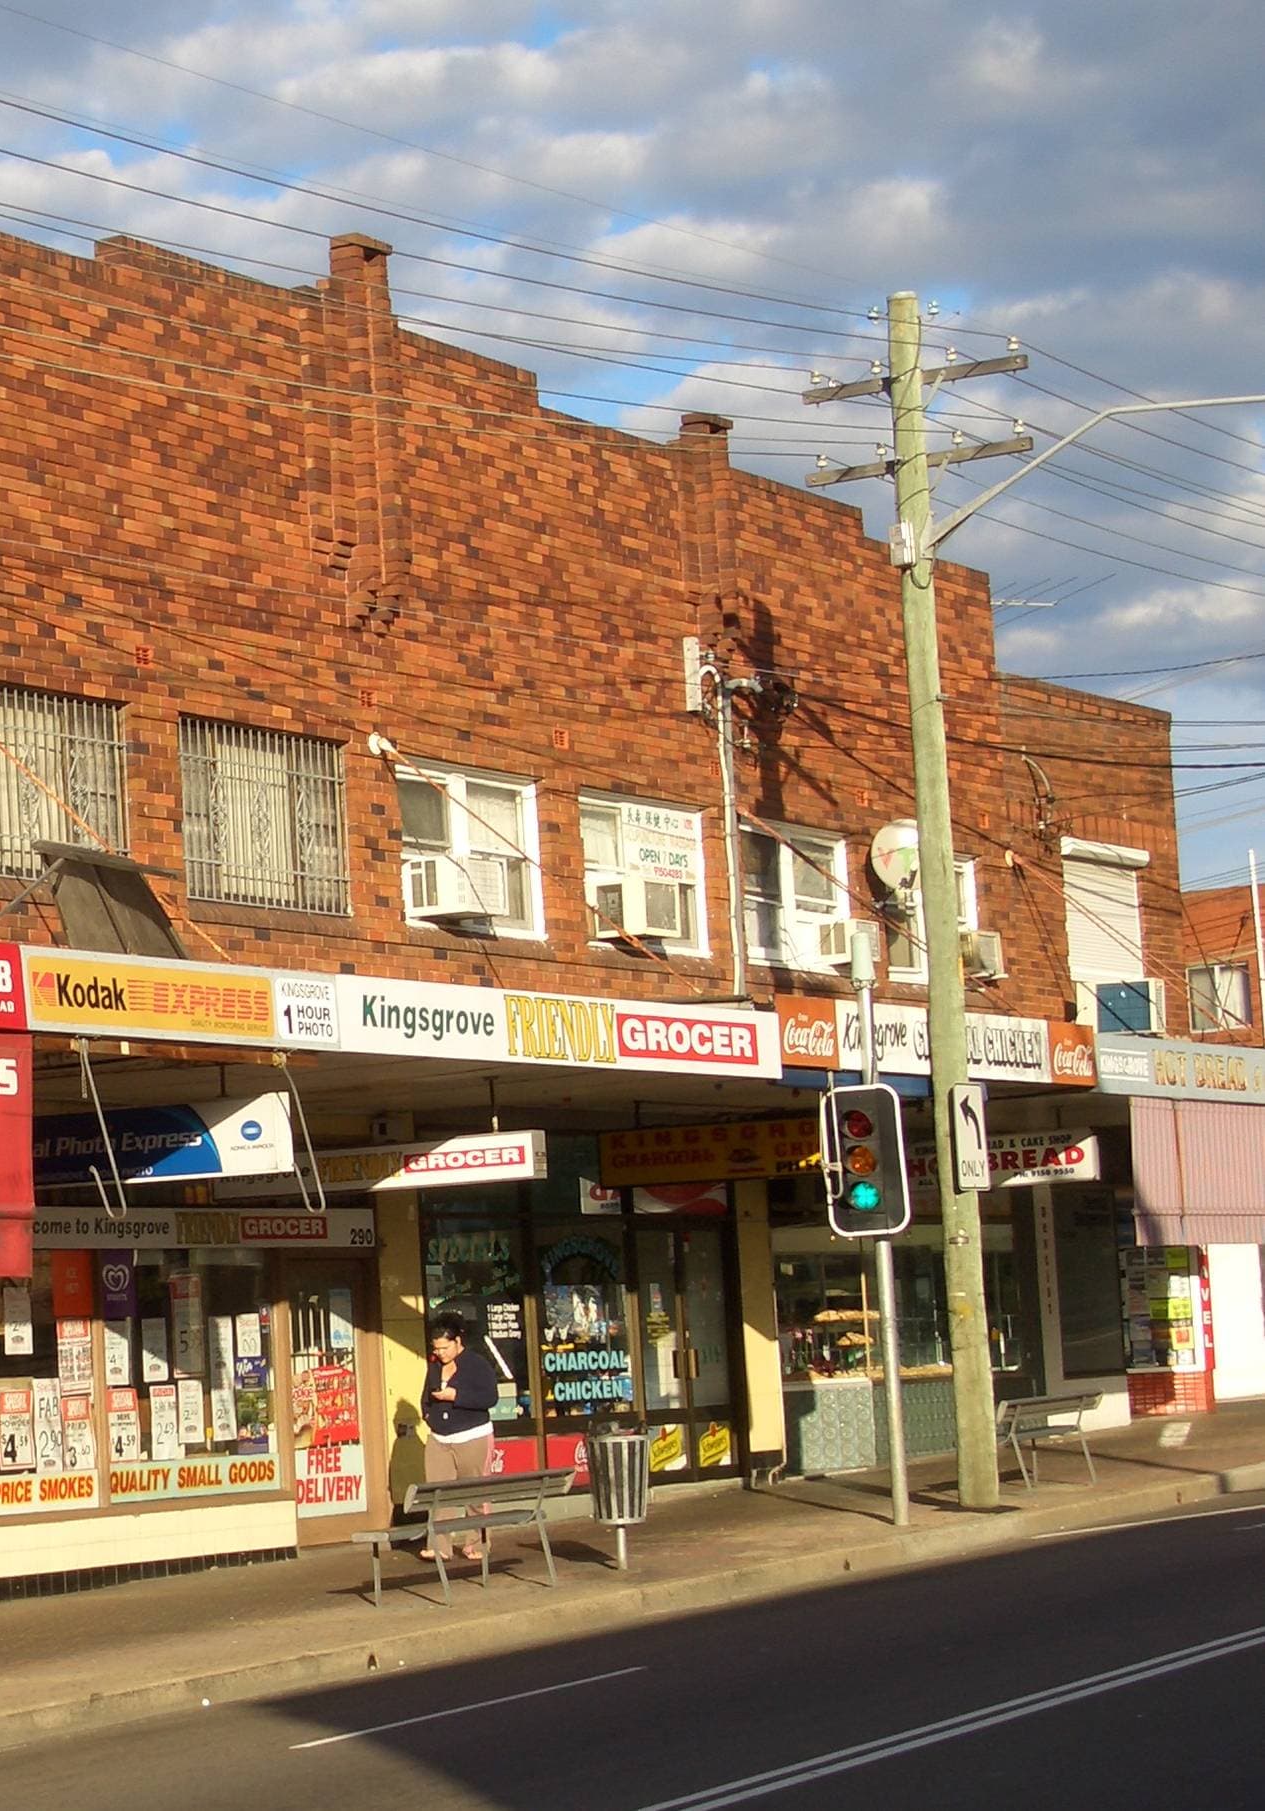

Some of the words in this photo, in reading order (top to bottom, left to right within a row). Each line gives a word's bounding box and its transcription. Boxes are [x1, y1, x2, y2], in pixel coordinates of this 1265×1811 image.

[639, 847, 661, 864] OPEN
[668, 852, 689, 869] DAYS
[57, 973, 127, 1012] Kodak
[152, 981, 271, 1022] EXPRESS
[281, 982, 330, 1001] KINGSGROVE
[284, 1004, 294, 1034] 1
[297, 1004, 331, 1021] HOUR
[298, 1021, 334, 1038] PHOTO
[361, 994, 496, 1040] Kingsgrove
[503, 993, 618, 1064] FRIENDLY
[620, 1016, 753, 1058] GROCER
[984, 1026, 1042, 1070] CHICKEN
[1100, 1054, 1150, 1077] KINGSGROVE
[1152, 1049, 1187, 1087] HOT
[1193, 1053, 1248, 1091] BREAD
[120, 1131, 203, 1155] Express
[1021, 1136, 1045, 1148] CAKE
[1048, 1134, 1073, 1146] SHOP
[407, 1148, 522, 1172] GROCER
[961, 1160, 986, 1178] ONLY
[988, 1145, 1085, 1172] BREAD
[75, 1217, 89, 1234] to
[94, 1216, 170, 1238] Kingsgrove
[244, 1218, 325, 1236] GROCER
[350, 1228, 373, 1246] 290
[544, 1350, 628, 1374] CHARCOAL
[553, 1379, 623, 1402] CHICKEN
[38, 1396, 60, 1419] FAB
[307, 1448, 342, 1475] FREE
[39, 1475, 94, 1502] SMOKES
[110, 1467, 171, 1494] QUALITY
[178, 1463, 223, 1489] SMALL
[228, 1459, 276, 1485] GOODS
[296, 1474, 363, 1504] DELIVERY
